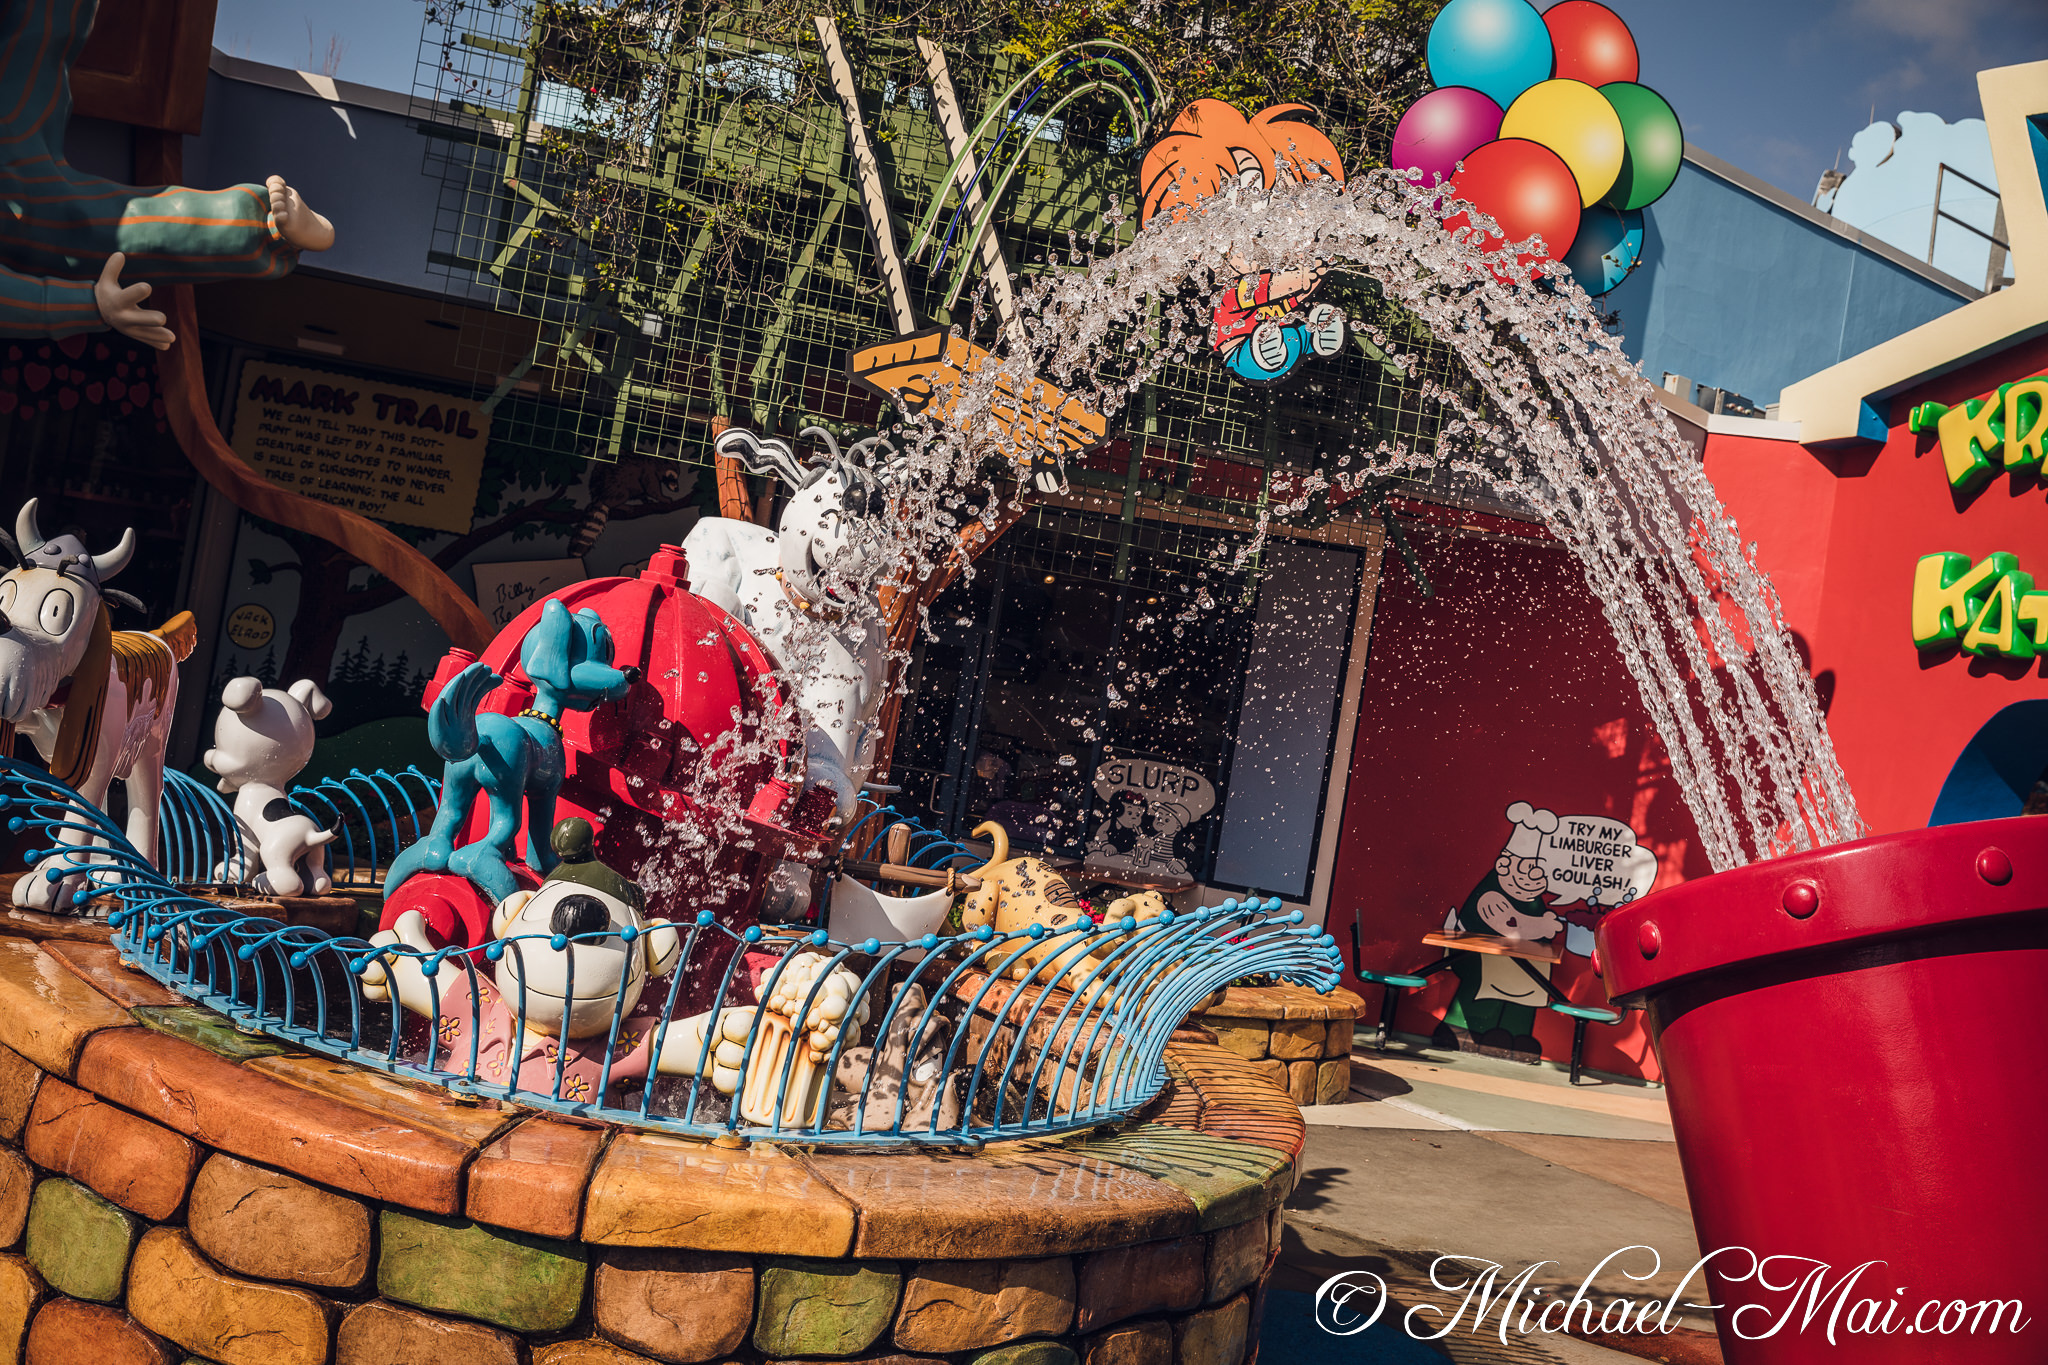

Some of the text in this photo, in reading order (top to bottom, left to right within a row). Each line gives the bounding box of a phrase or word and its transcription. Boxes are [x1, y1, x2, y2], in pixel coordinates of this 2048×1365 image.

[249, 375, 478, 439] MARK TRAIL
[263, 407, 445, 448] WE CAN TELL THAT THIS FOOT-
[256, 438, 312, 455] CREATURE
[317, 448, 340, 460] WHO
[345, 453, 380, 467] LOVES
[387, 460, 401, 472] TO
[259, 423, 443, 464] PRINT WAS LEFT BY A FAMILIAR
[254, 451, 264, 461] IS
[269, 454, 294, 467] FULL
[300, 460, 314, 469] OF
[380, 474, 406, 486] AND
[410, 479, 445, 494] NEVER
[265, 469, 424, 506] TIRES OF LEARNING: THE ALL
[358, 501, 386, 514] BOY!
[230, 624, 270, 639] ELROD
[236, 611, 268, 625] JACK
[1107, 764, 1200, 798] SLURP
[1568, 821, 1623, 841] TRY MY
[1550, 836, 1632, 858] LIMBURGER
[1571, 854, 1614, 872] LIVER
[1552, 868, 1631, 891] GOULASH!
